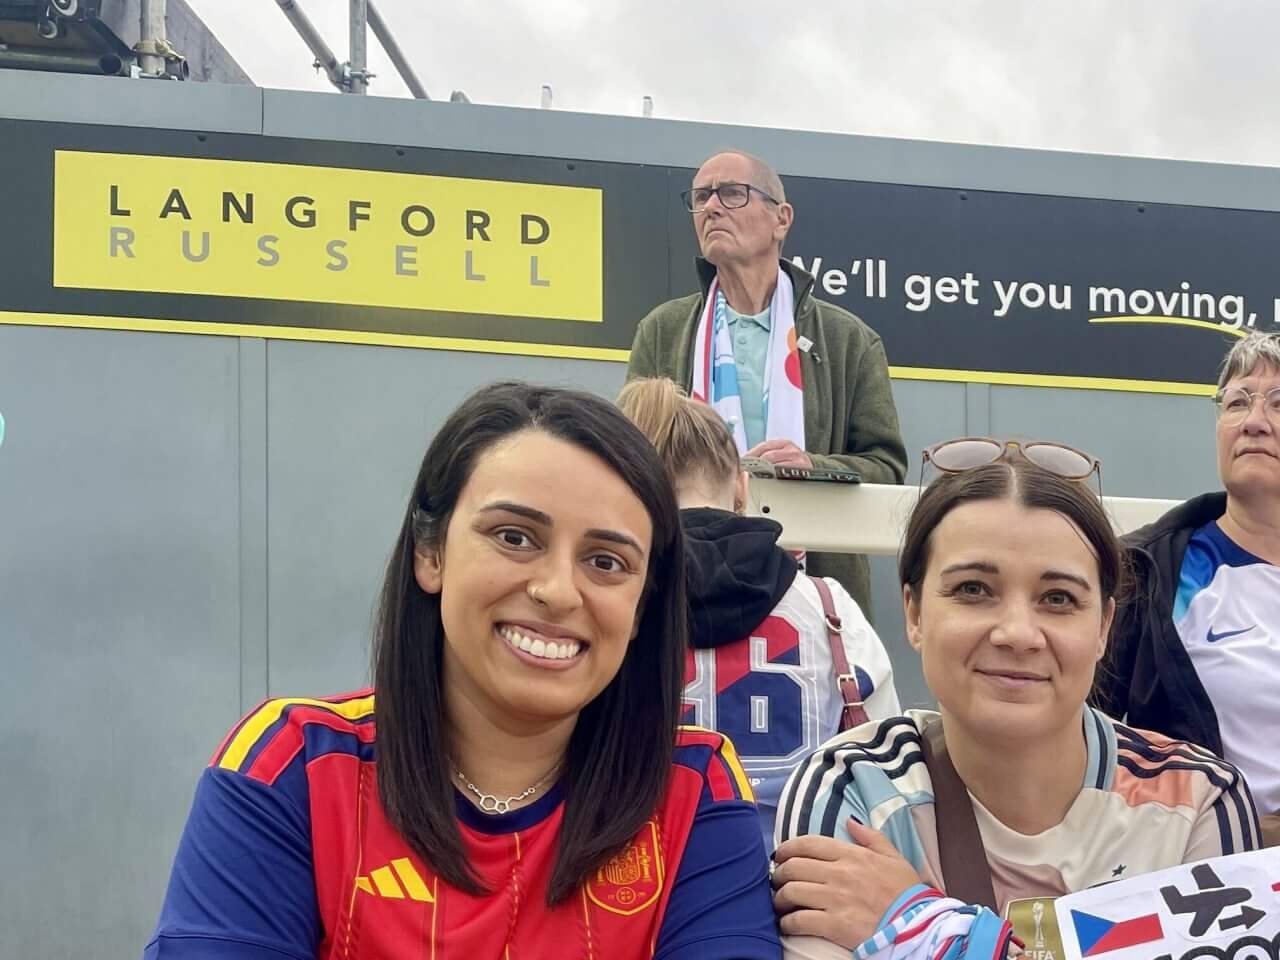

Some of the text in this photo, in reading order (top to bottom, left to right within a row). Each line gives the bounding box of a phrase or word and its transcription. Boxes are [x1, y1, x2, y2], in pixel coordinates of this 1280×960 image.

[109, 184, 550, 246] LANGFORD
[109, 226, 550, 288] RUSSELL
[904, 272, 979, 313] get
[993, 280, 1072, 317] you
[1089, 282, 1257, 330] moving,
[1024, 950, 1056, 960] FIFA
